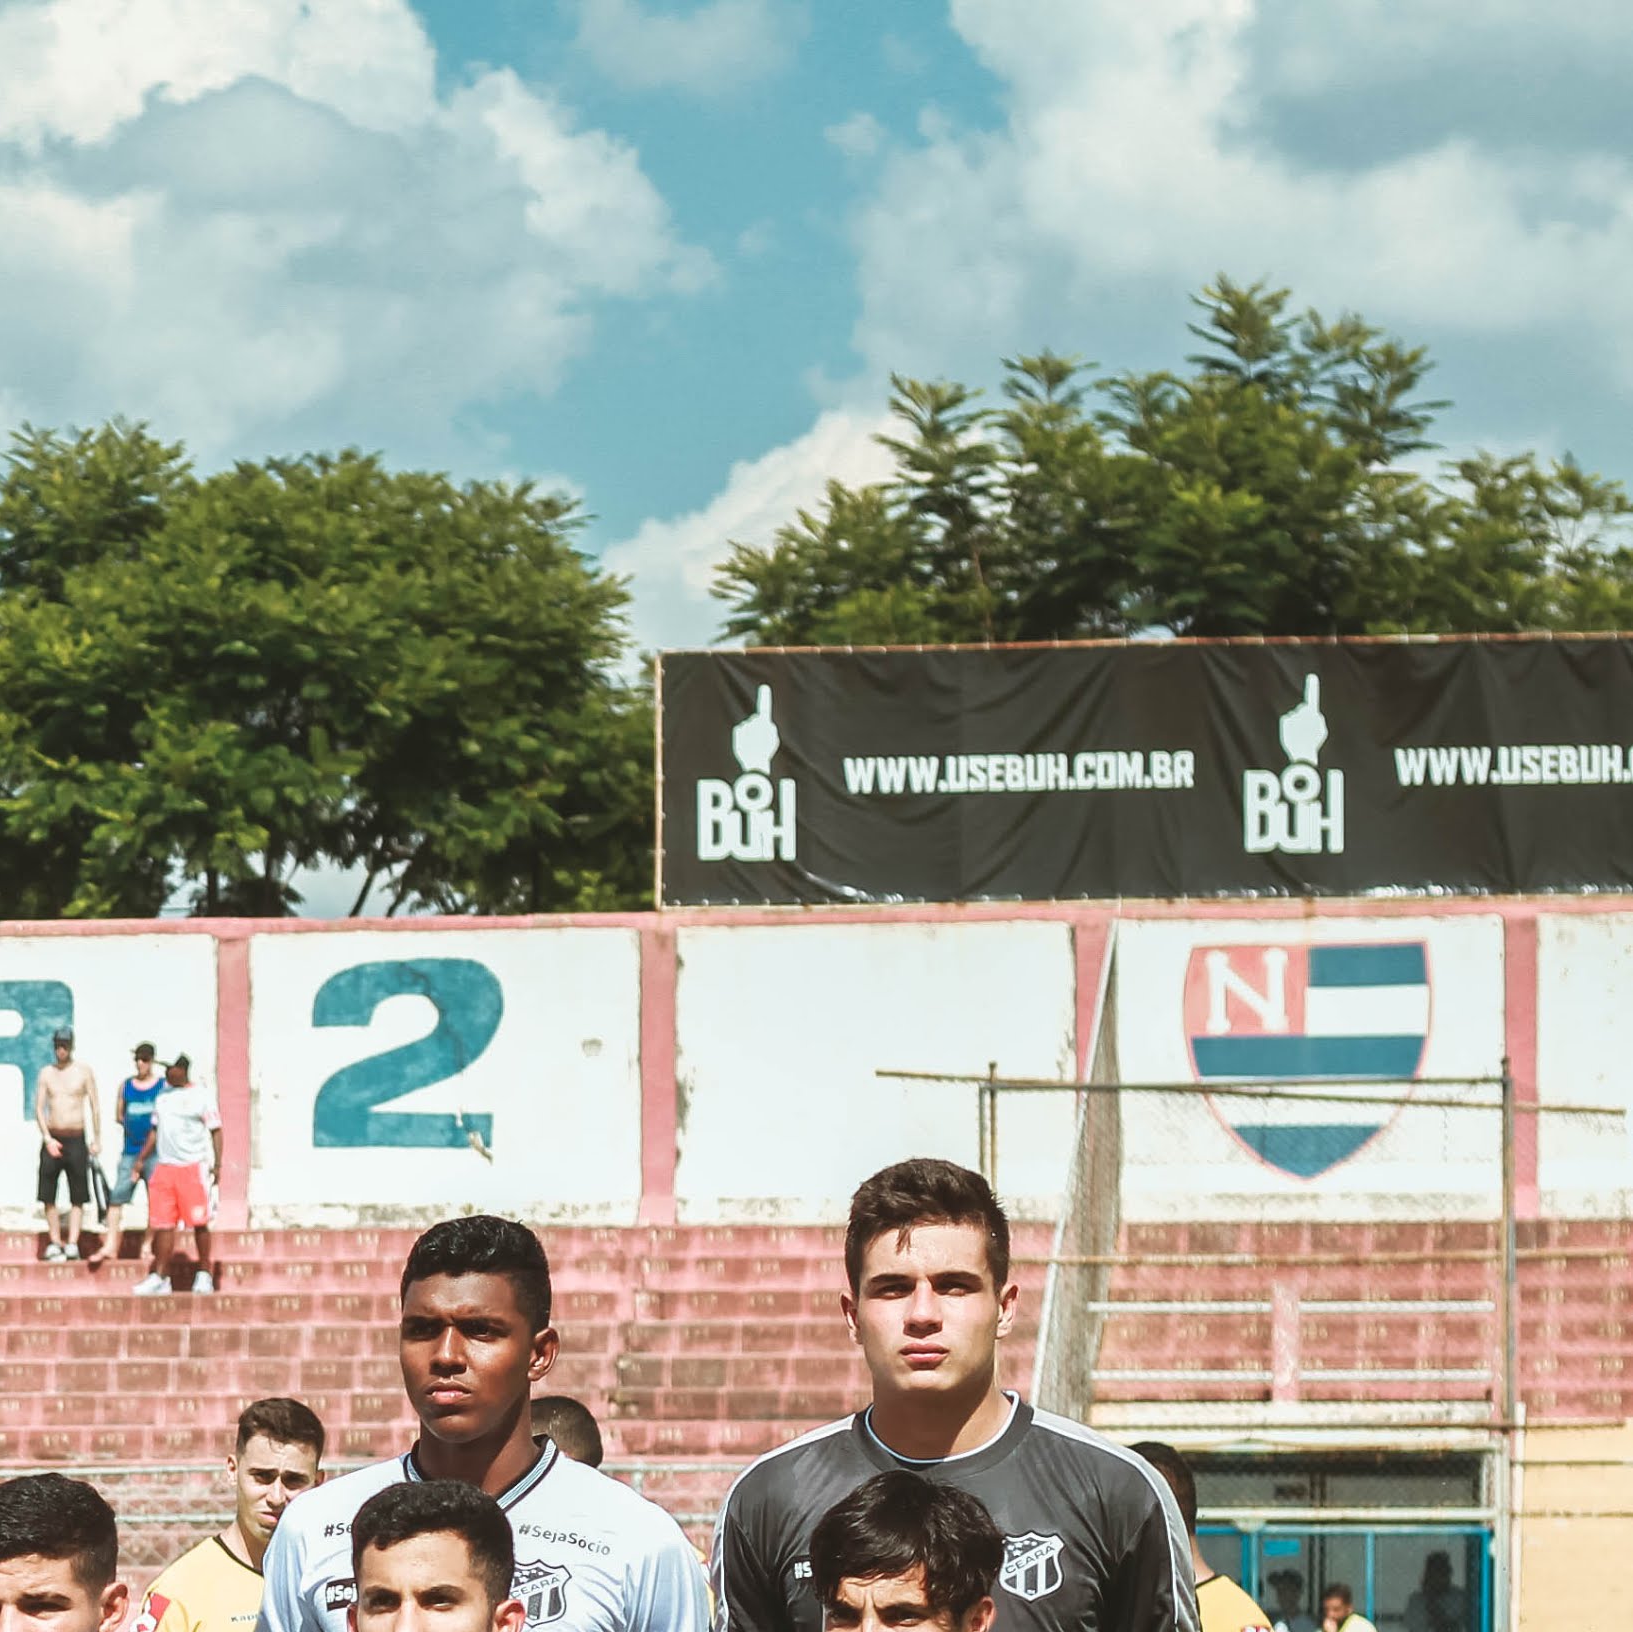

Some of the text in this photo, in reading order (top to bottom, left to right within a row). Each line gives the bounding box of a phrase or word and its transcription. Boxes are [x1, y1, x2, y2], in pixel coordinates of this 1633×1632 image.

[844, 750, 1196, 795] WWW.USEBUH.COM.BR
[1395, 743, 1633, 786] WWW.USEBUH.
[1205, 947, 1290, 1035] N
[312, 957, 505, 1150] 2
[518, 1521, 612, 1557] #SejaSócio
